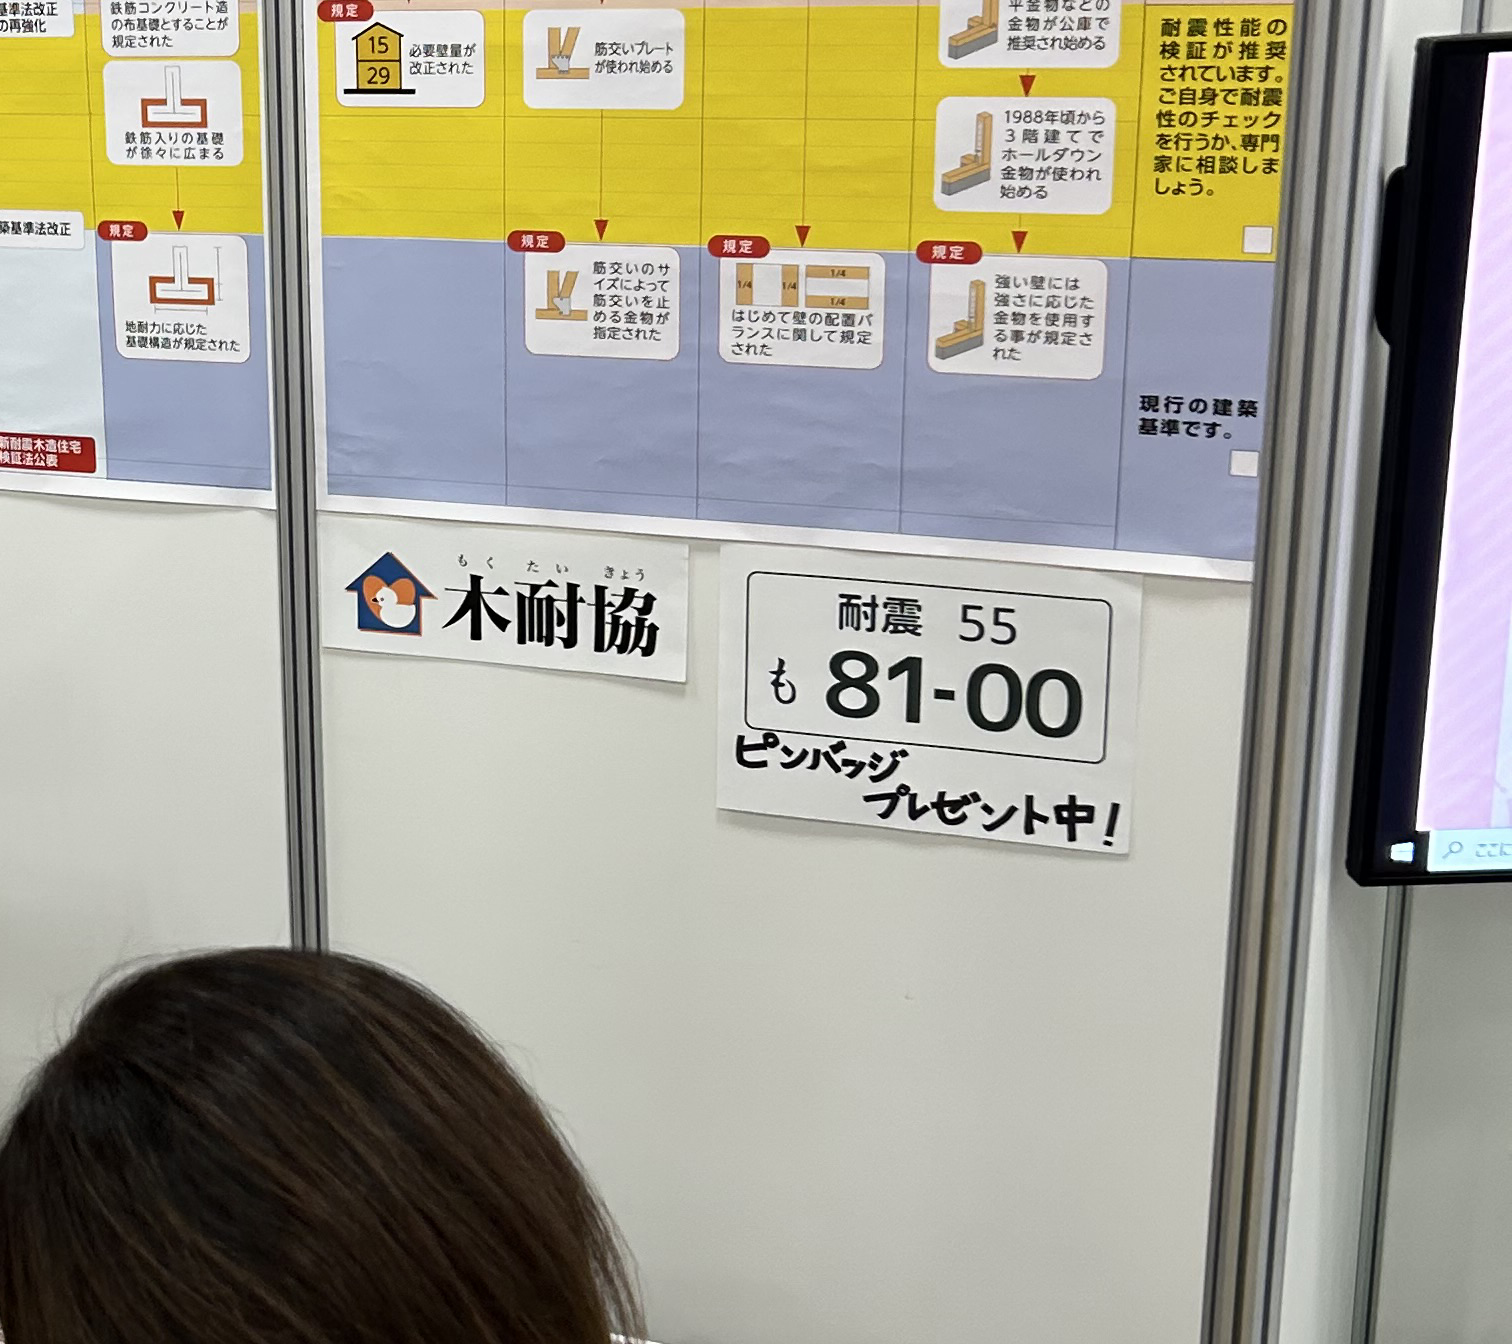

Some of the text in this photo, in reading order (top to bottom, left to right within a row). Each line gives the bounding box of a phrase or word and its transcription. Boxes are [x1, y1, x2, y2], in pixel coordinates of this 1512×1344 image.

[111, 1, 229, 15] 鉄筋コンクリート造
[112, 17, 229, 32] の布基礎とすることが
[1008, 16, 1110, 32] 金物が公庫で
[112, 35, 173, 49] 規定された
[595, 42, 673, 58] 筋交いプレート
[409, 61, 474, 76] 改正された
[595, 60, 673, 74] が使われ始める
[1004, 110, 1106, 126] 1988年頃から
[1156, 110, 1280, 129] 性のチェック
[125, 131, 224, 146] 鉄筋入りの基礎
[126, 146, 224, 160] が徐々に広まる
[1002, 148, 1102, 162] ホールダウン
[1001, 166, 1102, 182] 金物が使われ
[1000, 184, 1048, 200] 始める
[593, 261, 670, 277] 筋交いのサ
[593, 279, 670, 293] イズによって
[995, 275, 1080, 290] 強い壁には
[593, 295, 670, 309] 筋交いを止
[994, 293, 1095, 309] 強さに応じた
[593, 310, 670, 325] める金物が
[994, 311, 1094, 328] 金物を使用す
[125, 321, 207, 335] 地耐力に応じた
[993, 330, 1093, 346] る事が規定さ
[1139, 395, 1259, 418] 現行の建築
[442, 572, 660, 658] 木耐協
[838, 593, 1019, 646] 耐震 55
[769, 649, 1084, 739] も 81-00
[735, 731, 909, 782] ピンバッジ
